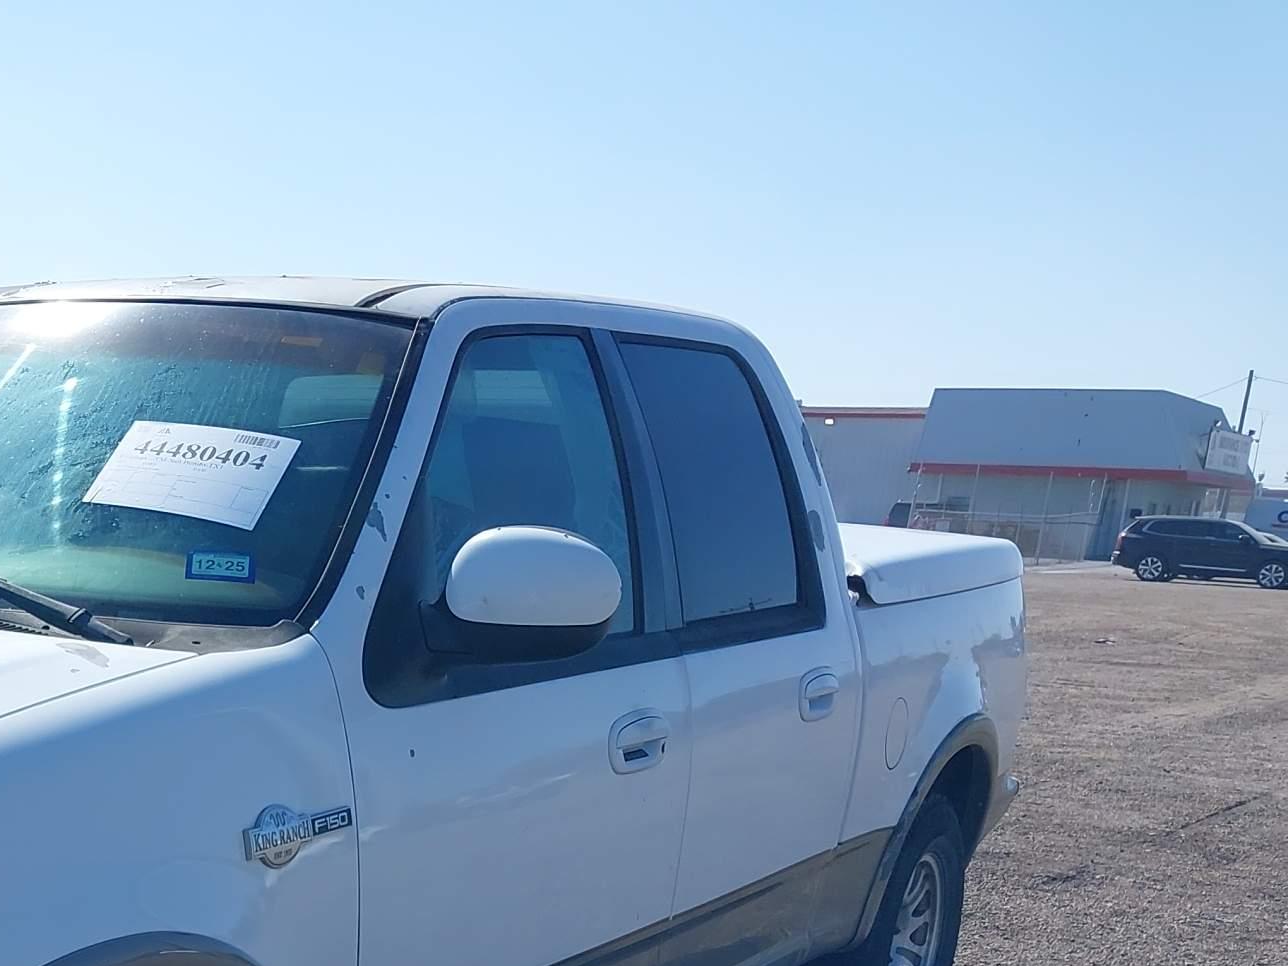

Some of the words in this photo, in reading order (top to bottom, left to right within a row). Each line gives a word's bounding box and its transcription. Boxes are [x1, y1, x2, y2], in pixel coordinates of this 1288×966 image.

[134, 440, 268, 470] 44480404
[195, 559, 216, 572] 12
[225, 559, 246, 573] 25
[314, 812, 349, 833] F150
[253, 831, 278, 852] KING
[279, 819, 310, 846] RANCH
